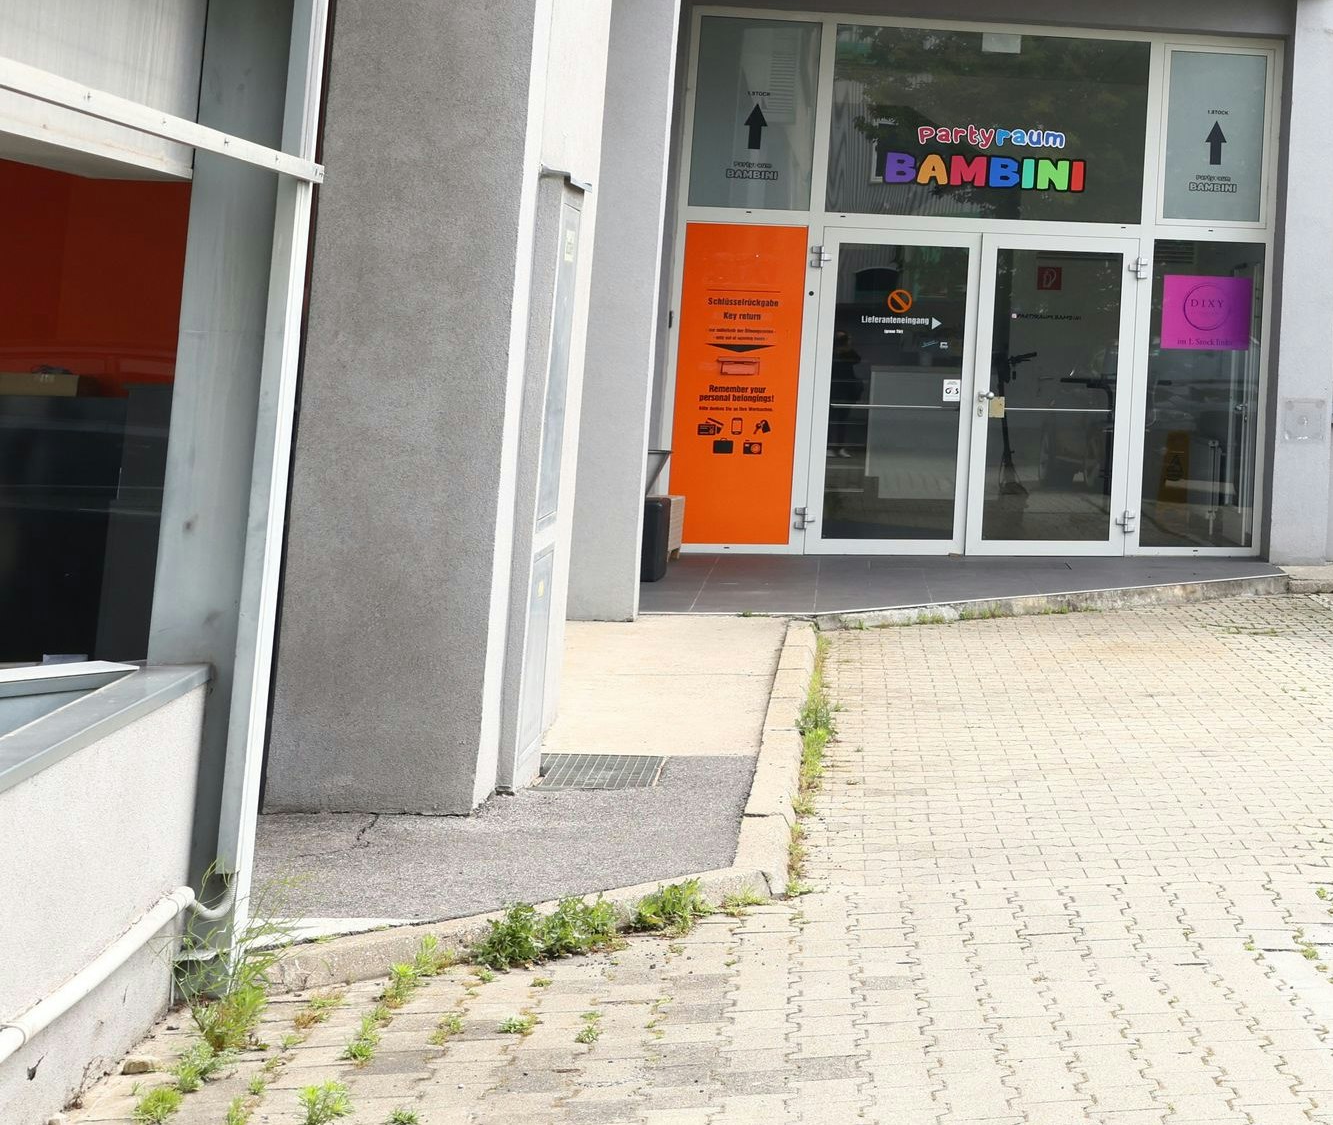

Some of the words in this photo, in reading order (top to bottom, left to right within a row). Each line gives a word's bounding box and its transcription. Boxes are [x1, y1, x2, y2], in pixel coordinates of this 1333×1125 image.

[917, 125, 1066, 149] Partyraum
[726, 168, 779, 180] BAMBINI
[884, 151, 1086, 192] BAMBINI
[1188, 181, 1237, 193] BAMBINI
[708, 297, 779, 308] Schlüsselrückgabe
[1190, 299, 1224, 308] DIXY
[723, 312, 737, 321] Key
[739, 312, 761, 320] return
[861, 315, 930, 325] Lieferanteneingang
[1195, 338, 1214, 346] Stock
[709, 385, 748, 393] Remember
[945, 387, 959, 395] GS
[699, 394, 731, 402] personal
[732, 394, 774, 403] belongings!
